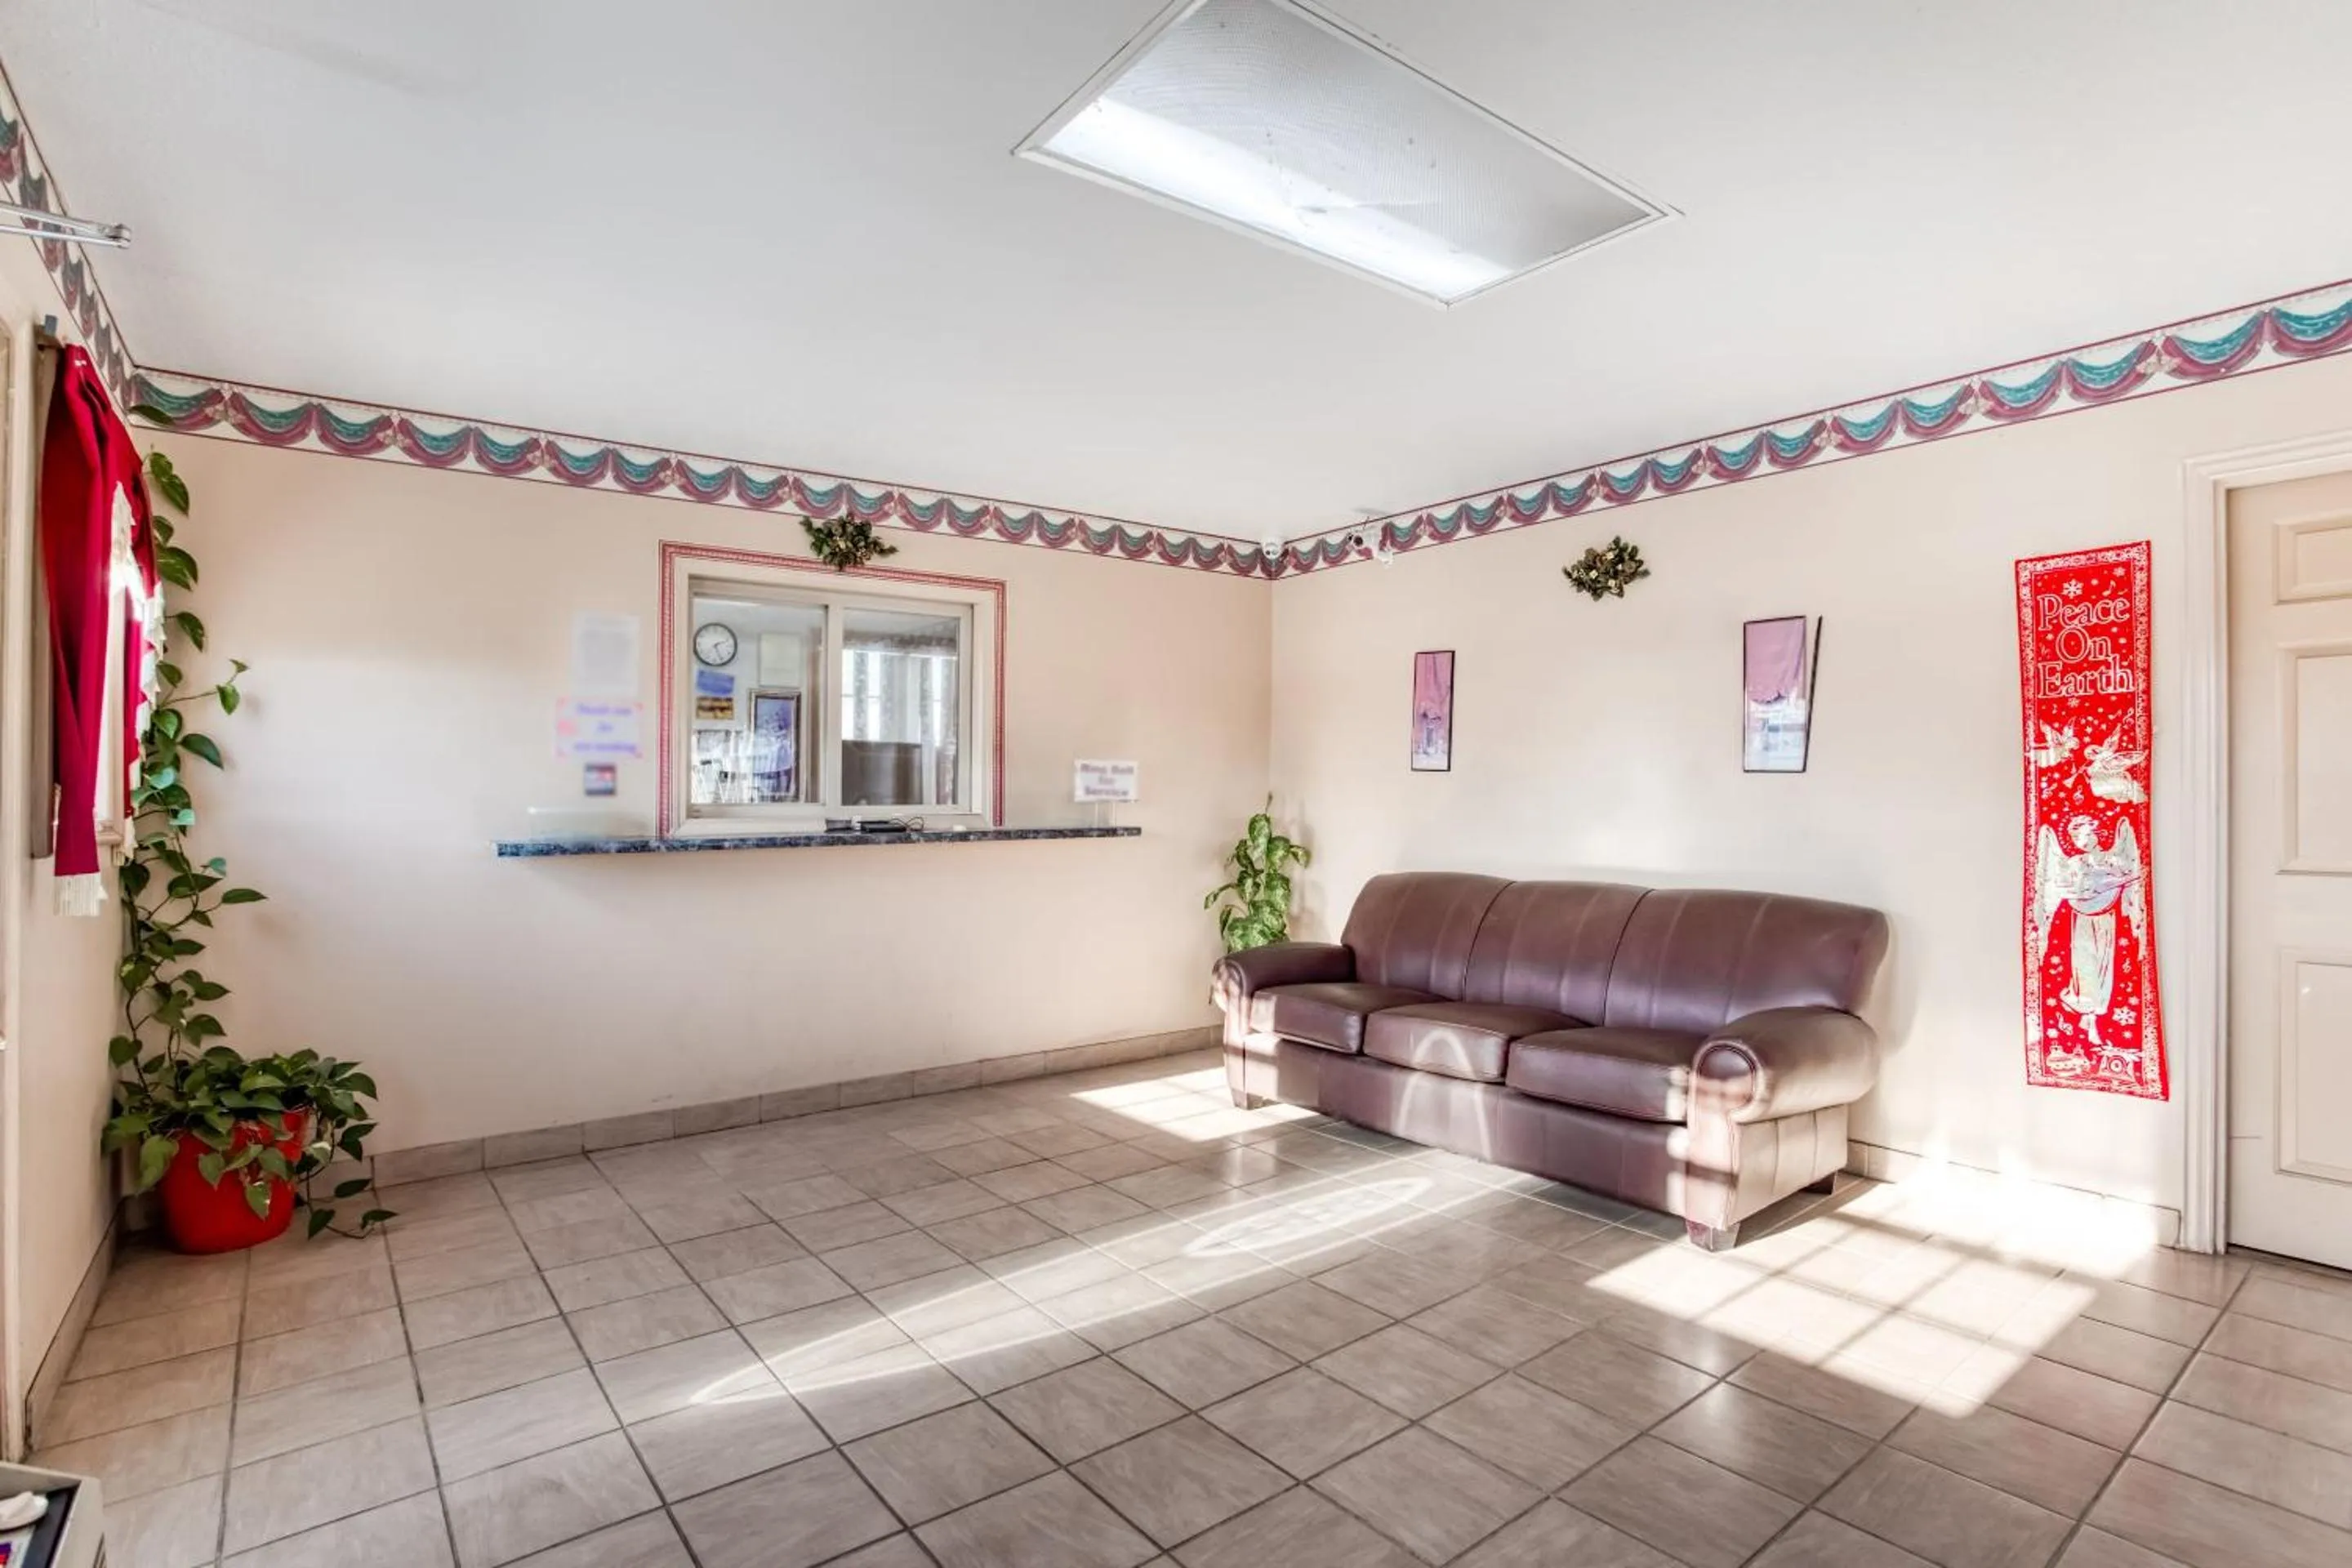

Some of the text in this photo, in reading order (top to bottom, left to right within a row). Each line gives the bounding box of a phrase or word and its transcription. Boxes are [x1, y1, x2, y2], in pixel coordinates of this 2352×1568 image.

[2037, 594, 2130, 630] Peace
[2056, 626, 2112, 663] On
[2037, 654, 2135, 698] Earth
